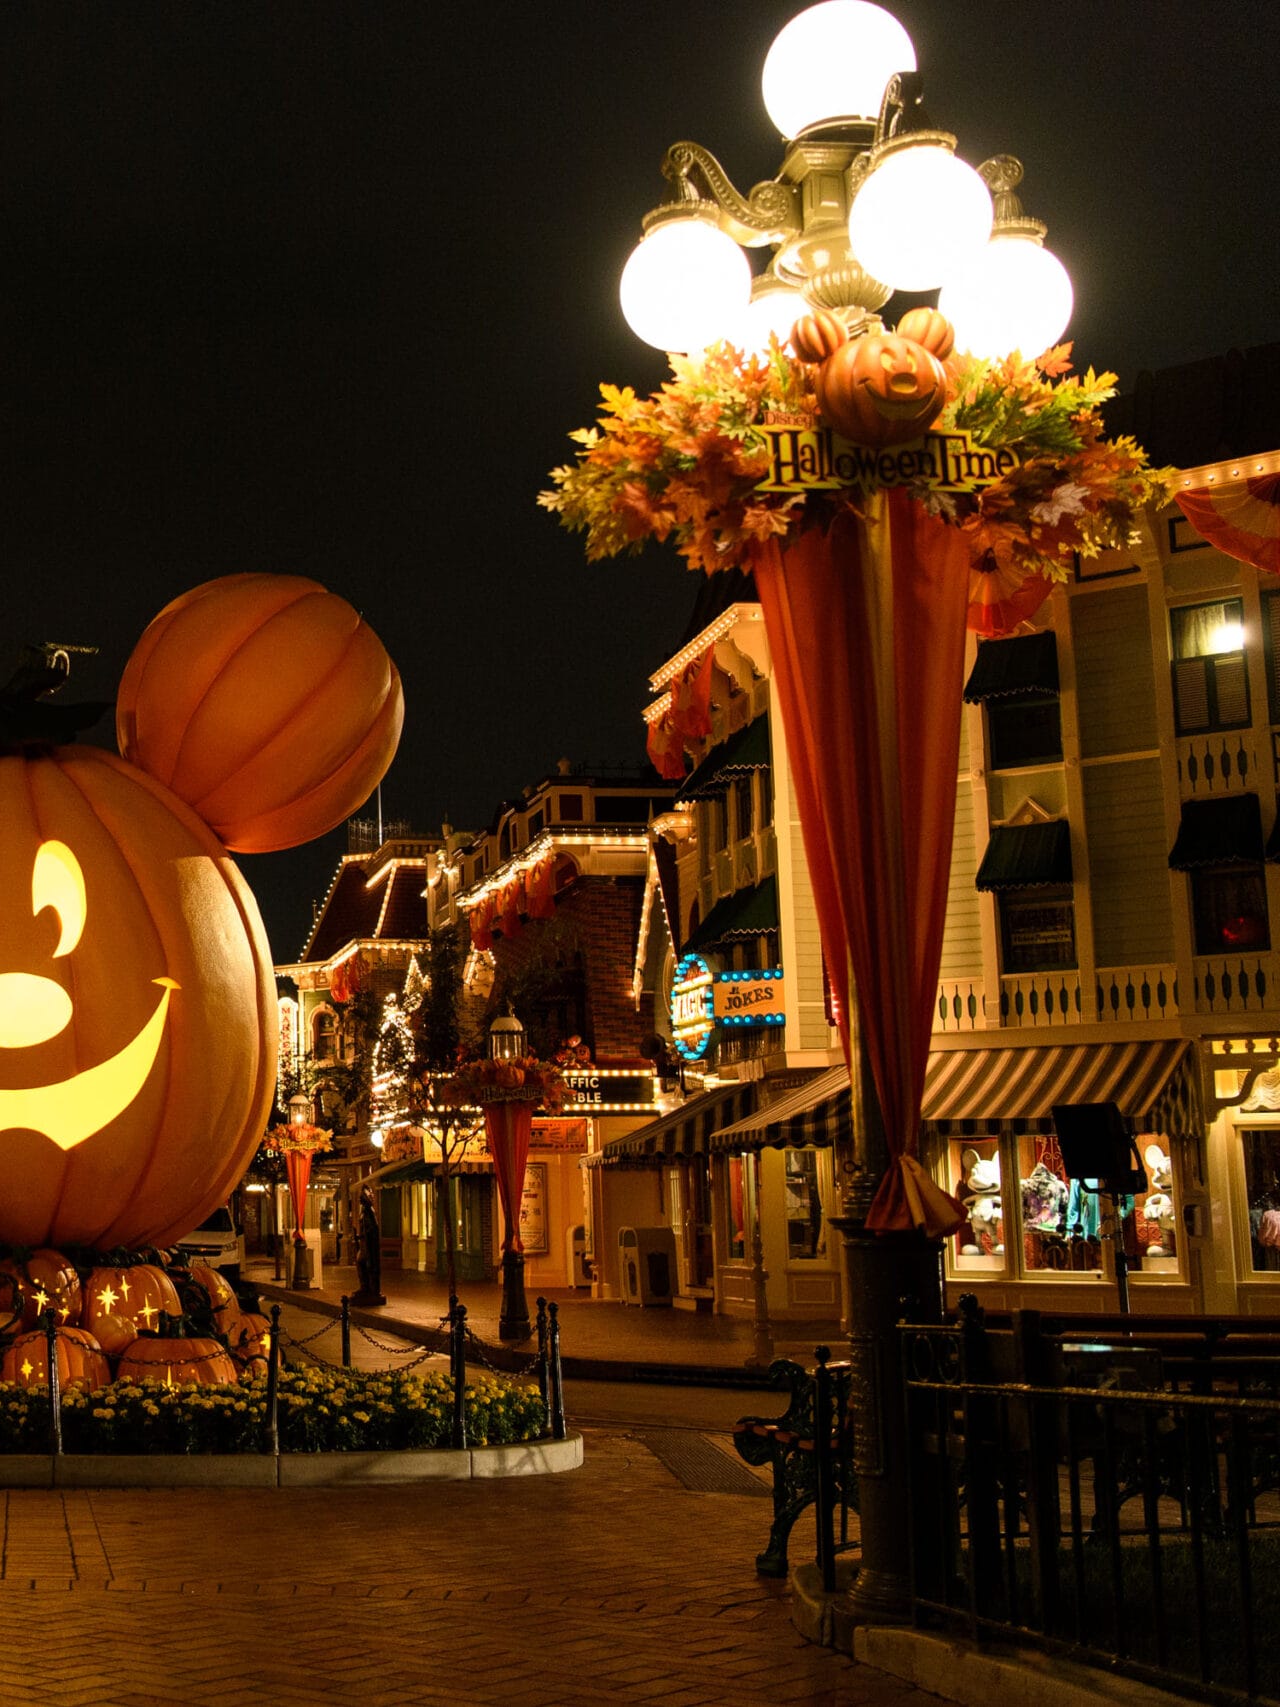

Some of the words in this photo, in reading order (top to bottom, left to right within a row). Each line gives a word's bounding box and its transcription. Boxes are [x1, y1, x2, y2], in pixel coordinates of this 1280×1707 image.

[724, 986, 774, 1010] JOKES
[564, 1077, 600, 1089] FFIC
[573, 1092, 602, 1103] BLE
